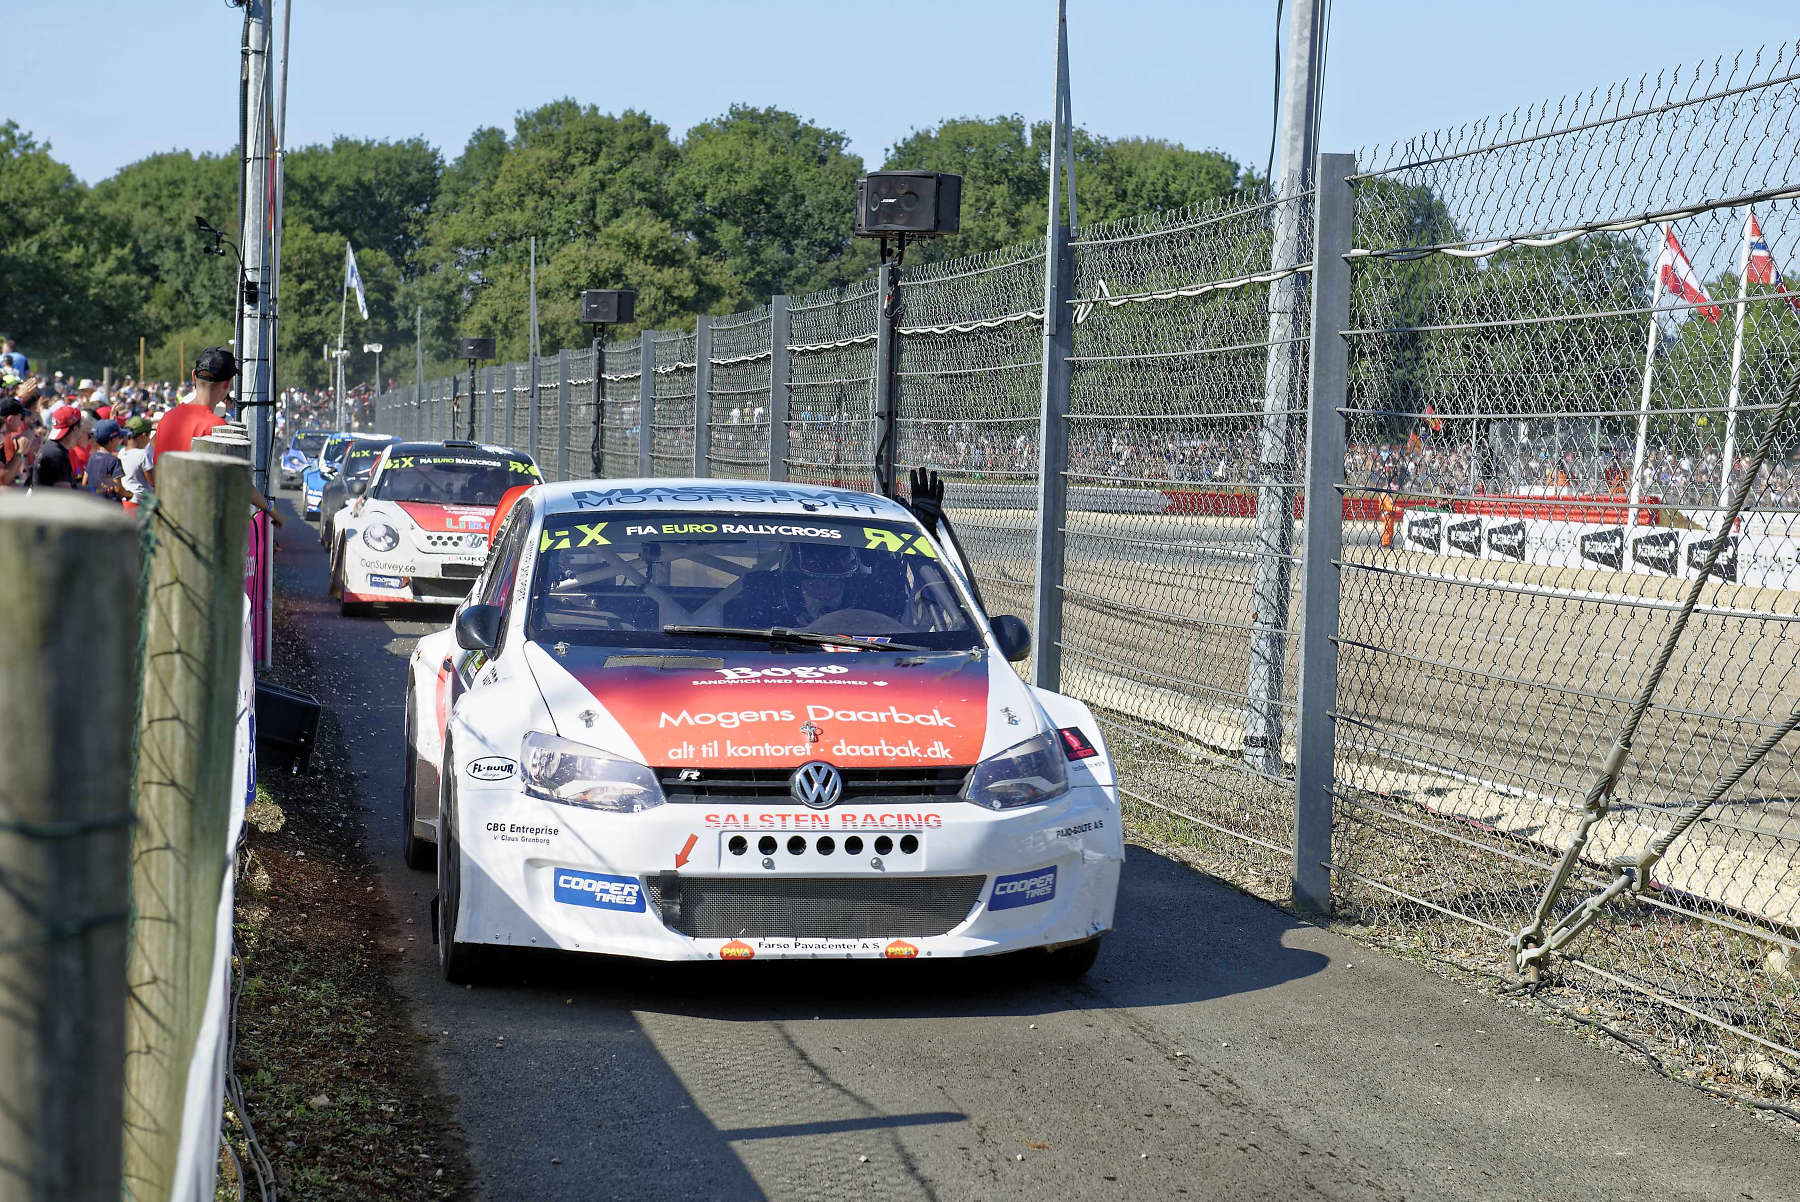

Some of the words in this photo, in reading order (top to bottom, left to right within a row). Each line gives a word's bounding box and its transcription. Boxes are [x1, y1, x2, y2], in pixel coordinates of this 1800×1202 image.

[456, 458, 502, 467] RALLYCROSS
[577, 494, 884, 514] MOTORSPORT
[626, 526, 658, 536] FIA
[662, 524, 718, 534] EURO
[722, 524, 842, 539] RALLYCROSS
[659, 709, 795, 728] Mogens
[806, 705, 956, 728] Daarbak
[668, 741, 695, 759] alt
[701, 740, 718, 758] til
[726, 739, 812, 757] kontoret
[832, 738, 952, 759] daarbak.dk
[487, 823, 506, 832] CBG
[510, 824, 559, 836] Entreprise
[705, 813, 831, 830] SALSTEN
[841, 813, 943, 830] RACING
[559, 875, 639, 896] COOPER
[995, 873, 1055, 895] COOPER
[594, 893, 638, 905] TIRES
[1026, 886, 1052, 899] TIRES
[794, 942, 857, 950] Pavacenter
